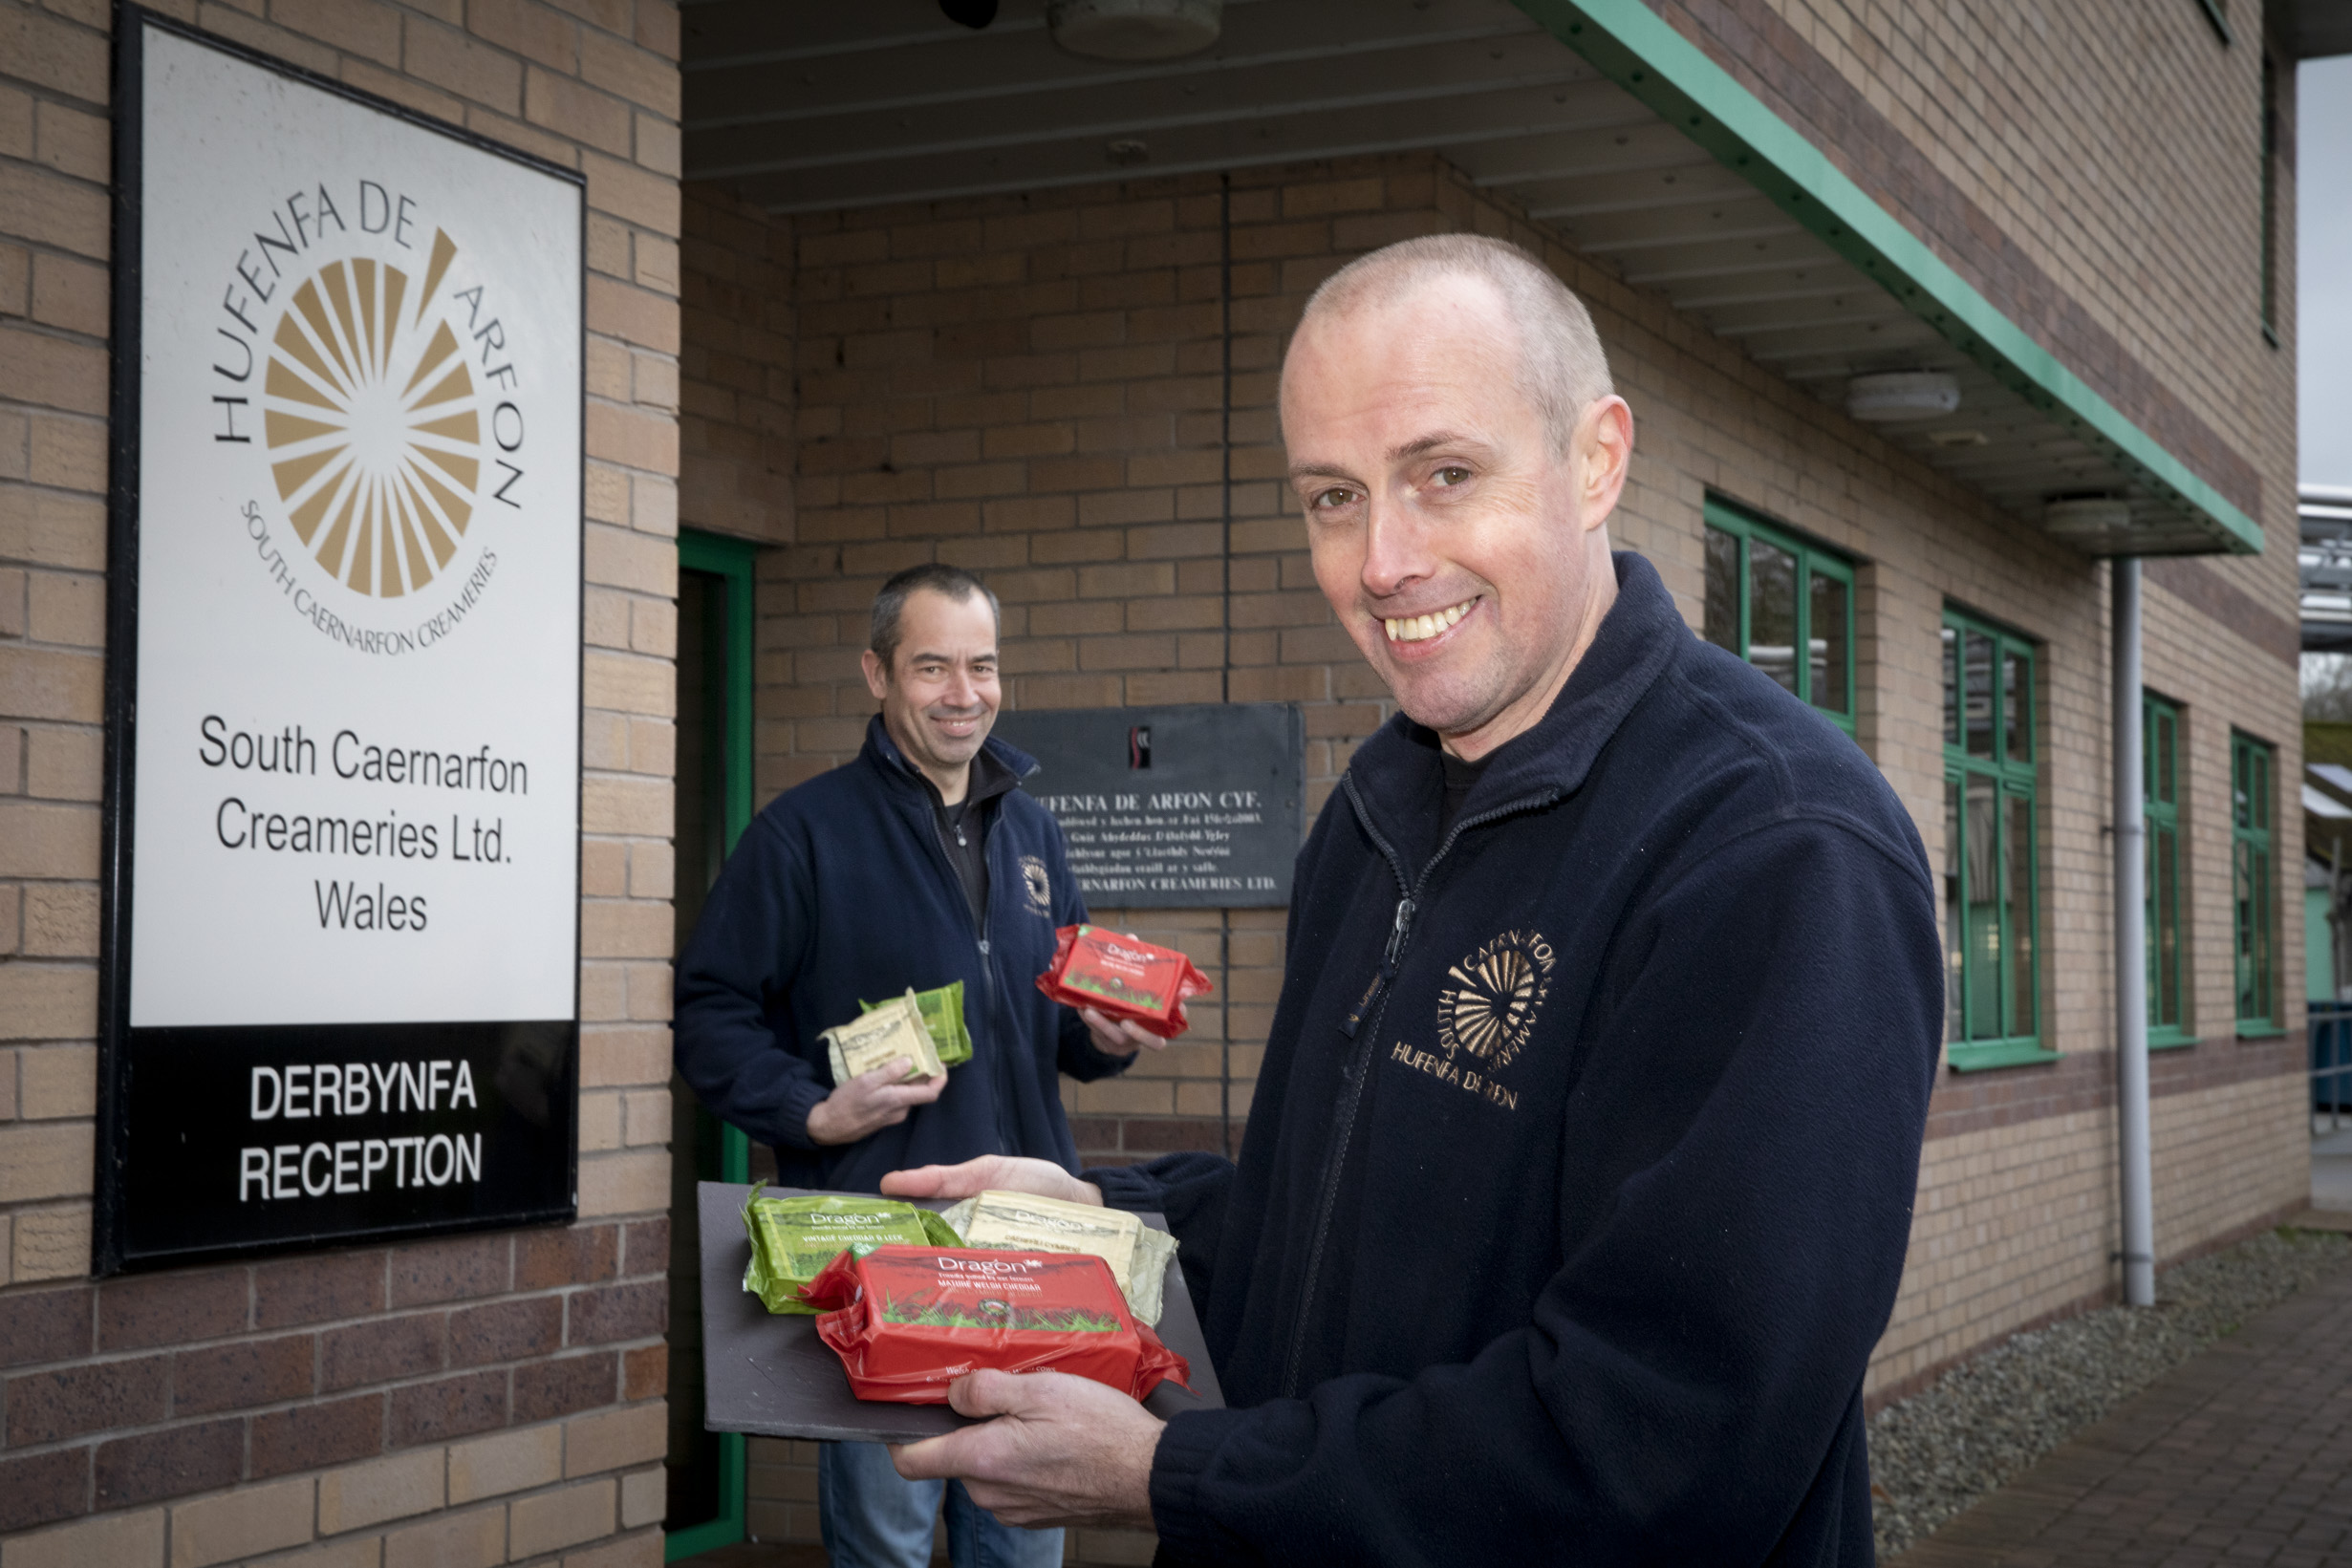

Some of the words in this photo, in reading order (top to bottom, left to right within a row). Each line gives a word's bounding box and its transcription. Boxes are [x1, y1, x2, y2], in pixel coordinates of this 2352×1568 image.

[212, 182, 347, 444] HUFENFA
[359, 179, 418, 249] DE
[453, 285, 525, 509] ARFON
[241, 499, 296, 595] SOUTH
[293, 588, 416, 656] CAERNARFON
[417, 546, 499, 649] CREAMERIES
[199, 714, 316, 776] South
[332, 729, 529, 795] Caernarfon
[1035, 795, 1108, 812] UFENFA
[1115, 793, 1141, 811] DE
[1148, 791, 1212, 810] ARFON
[1219, 791, 1262, 808] CYF.
[216, 797, 438, 860] Creameries
[452, 814, 512, 865] Ltd.
[314, 879, 428, 932] Wales
[1150, 877, 1242, 891] CREAMERIES
[1391, 1041, 1459, 1085] HUFENFA
[250, 1060, 478, 1121] DERBYNFA
[239, 1133, 482, 1202] RECEPTION
[810, 1213, 881, 1226] Dragon
[938, 1257, 1027, 1277] Dragon
[938, 1279, 971, 1289] MATURE
[973, 1281, 1002, 1290] WELSH
[1003, 1282, 1042, 1292] CHEDDAR
